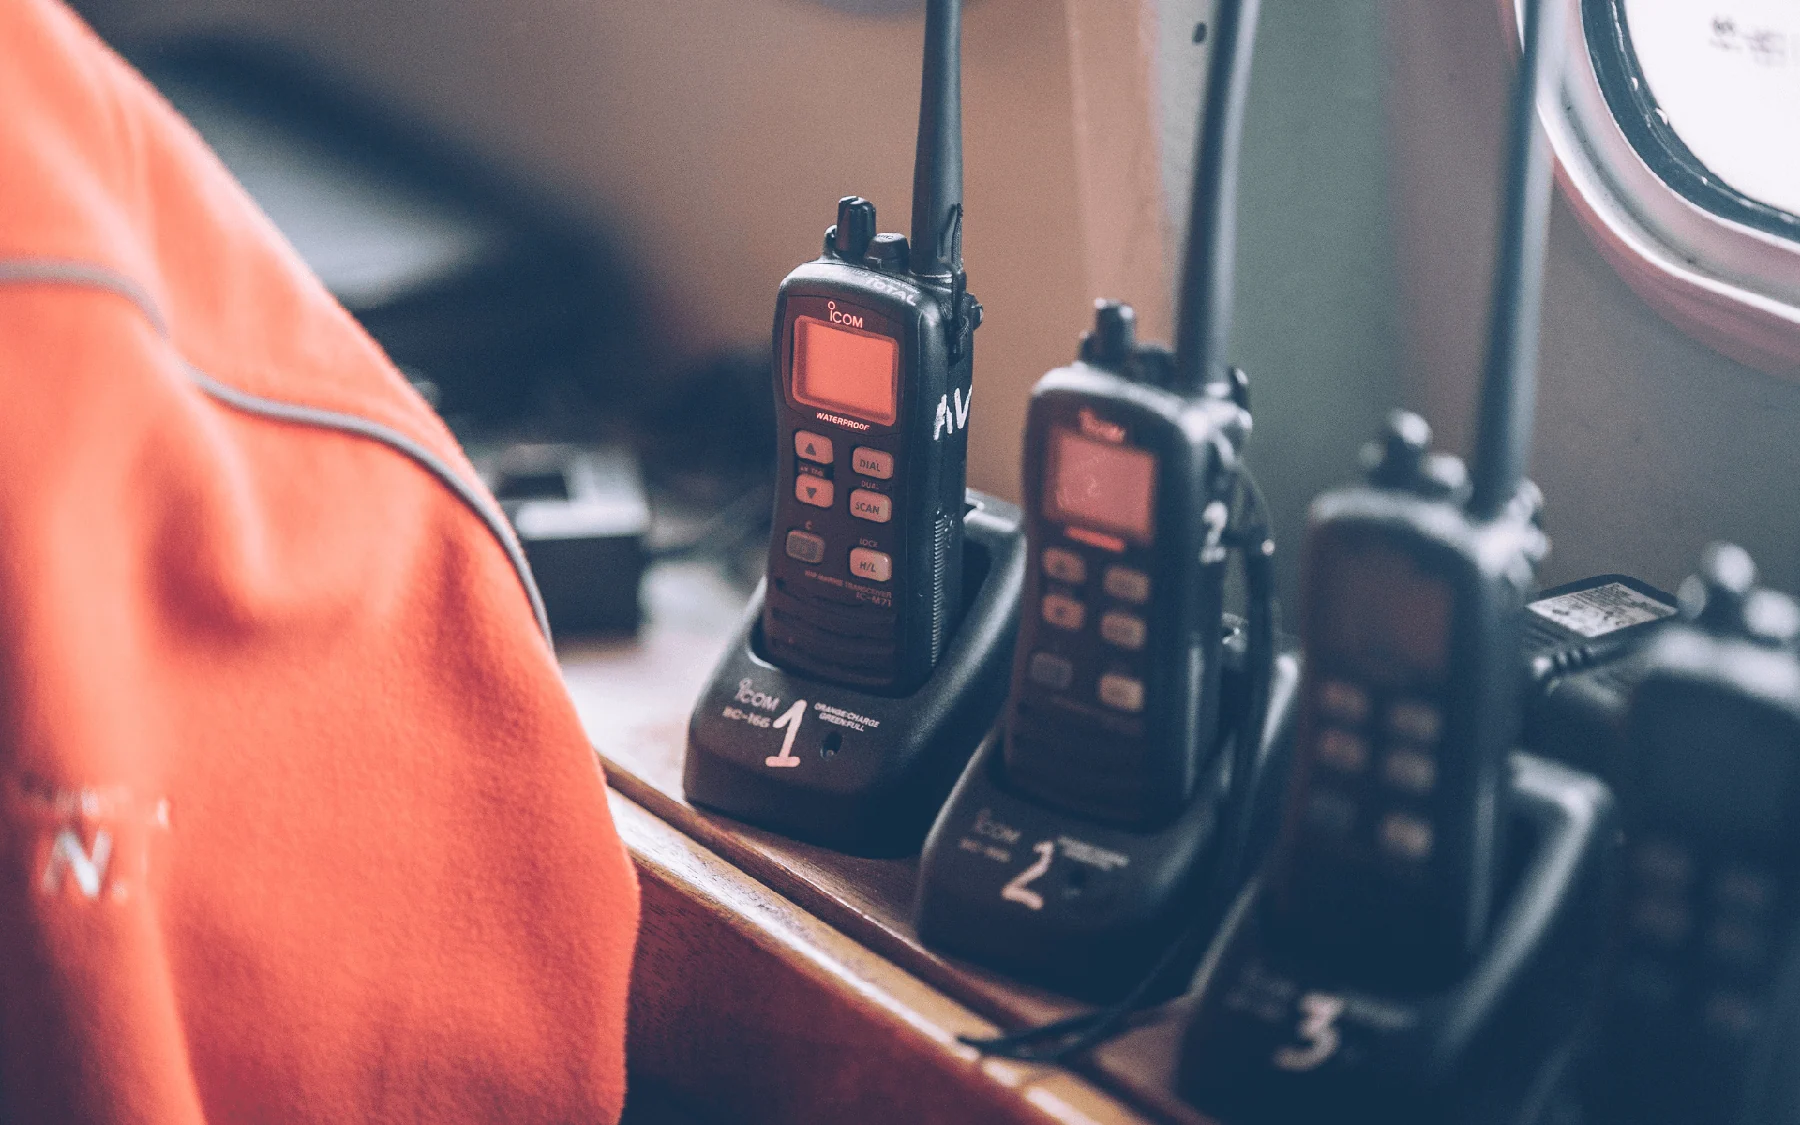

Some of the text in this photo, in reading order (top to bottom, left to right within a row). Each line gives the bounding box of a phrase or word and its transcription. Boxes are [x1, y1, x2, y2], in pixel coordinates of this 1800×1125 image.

[816, 411, 870, 431] WATERPROOF
[860, 459, 881, 472] DIAL
[854, 501, 880, 516] SCAN
[859, 561, 877, 573] H/L
[765, 699, 808, 768] 1
[1001, 840, 1054, 911] 2
[1273, 990, 1346, 1071] 3
